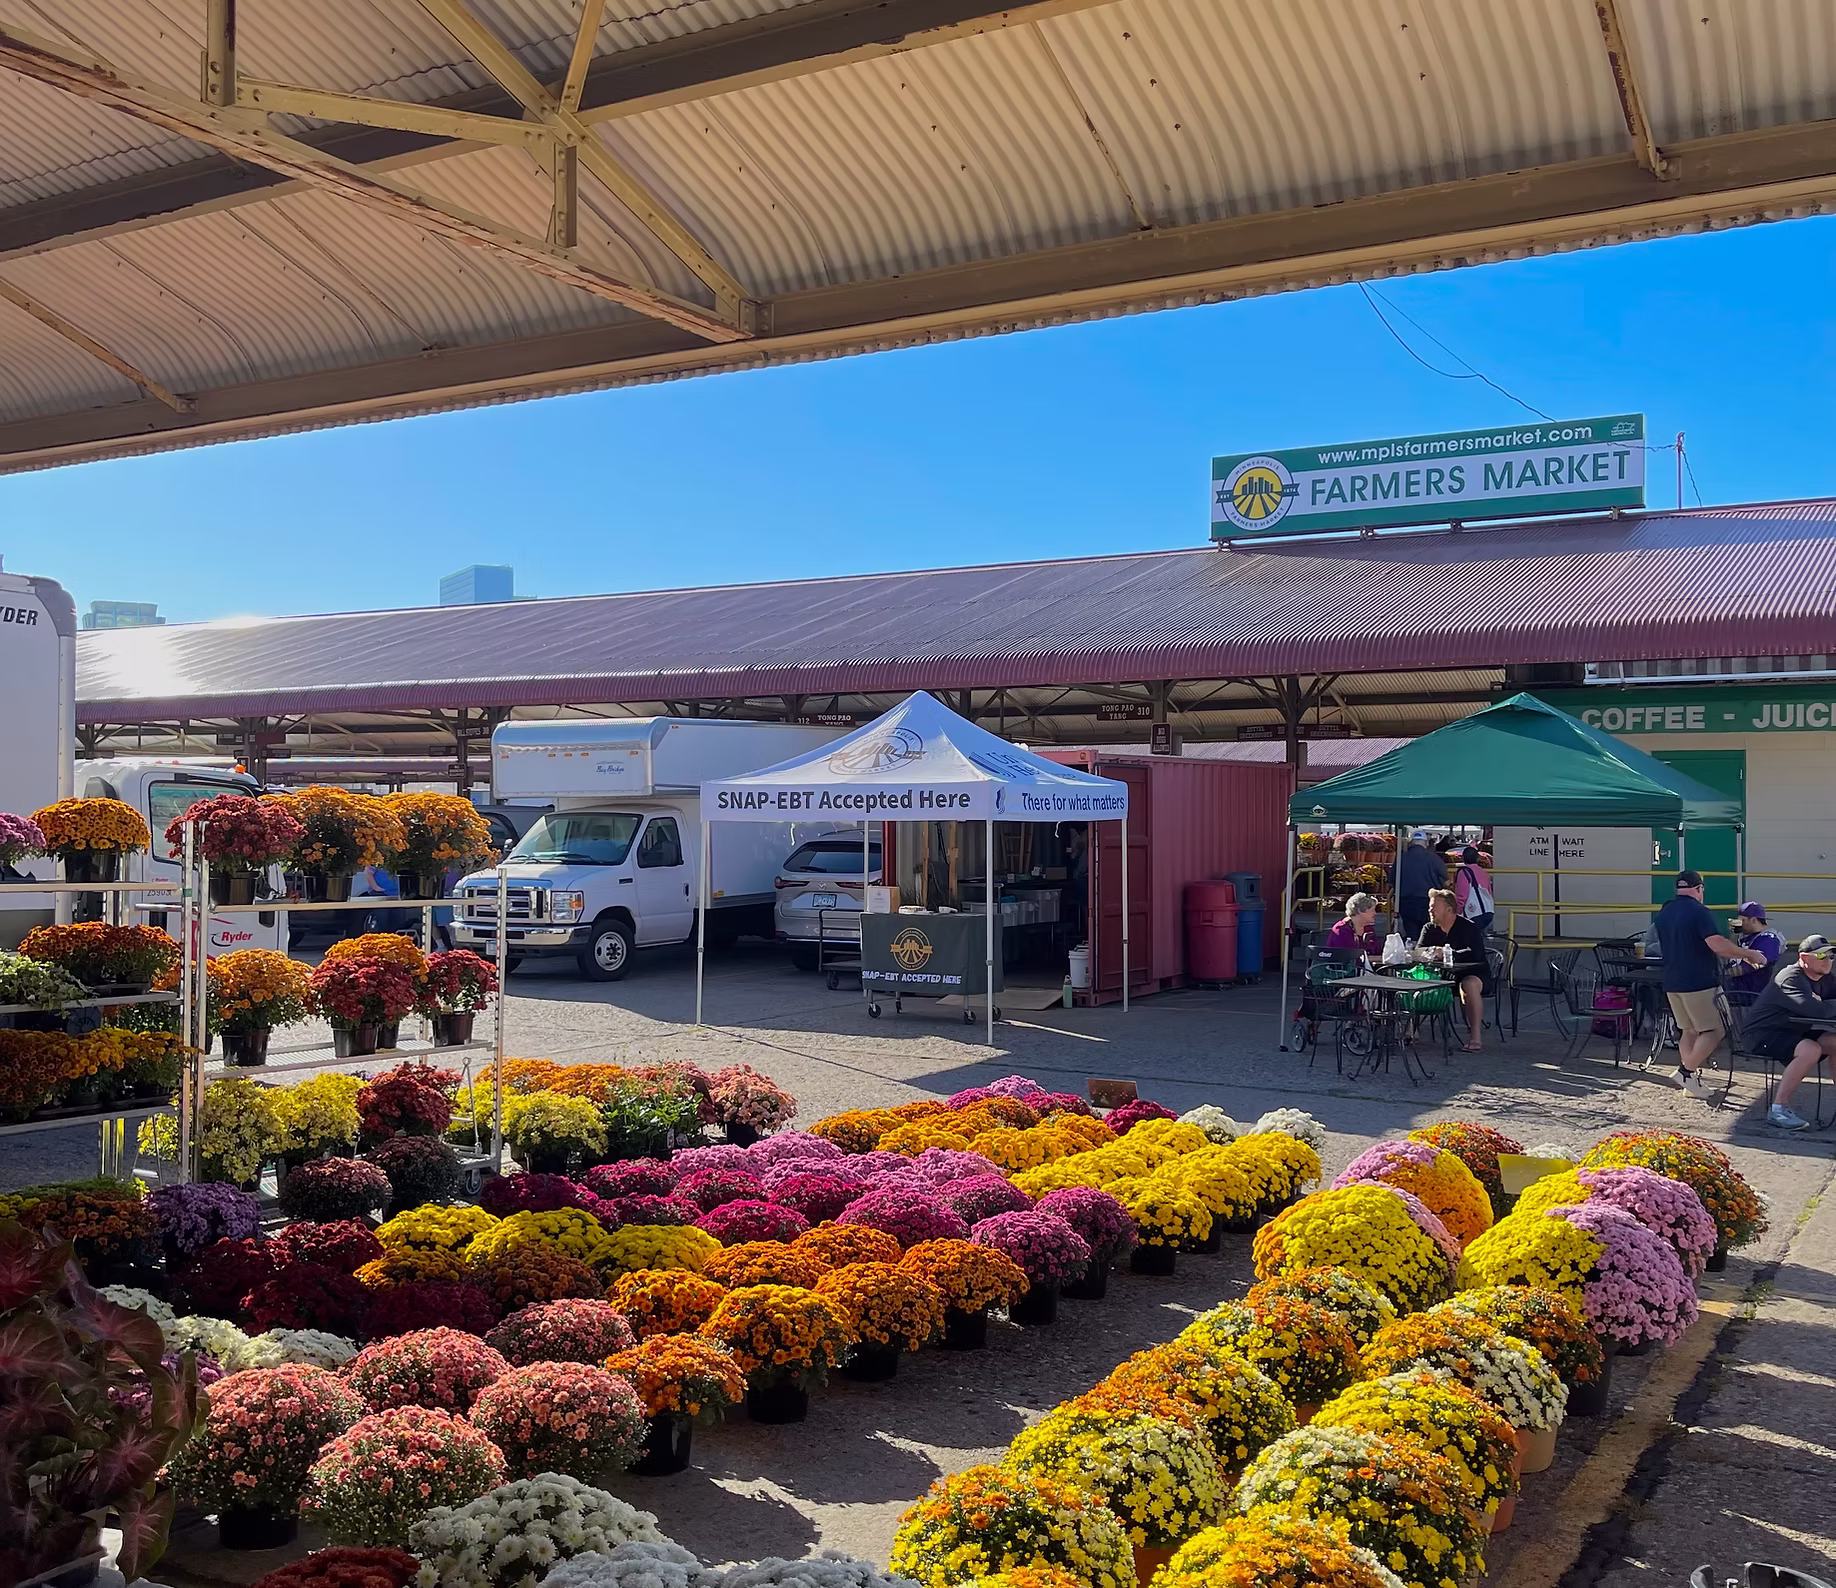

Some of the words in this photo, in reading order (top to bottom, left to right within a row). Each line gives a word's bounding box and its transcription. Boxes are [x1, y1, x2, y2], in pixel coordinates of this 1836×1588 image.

[1317, 424, 1592, 464] www.mplsfarmersmarket.com
[1235, 460, 1280, 475] MINNEAPOLIS
[1310, 465, 1466, 506] FARMERS
[1483, 450, 1630, 491] MARKET
[1230, 511, 1258, 528] FARMERS
[1260, 507, 1284, 527] MARKET
[1102, 704, 1119, 712] TONG
[1137, 706, 1150, 715] 310
[1581, 705, 1705, 731] COFFEE
[1752, 702, 1836, 729] JUIC
[717, 791, 814, 810] SNAP-EBT
[819, 789, 913, 813] Accepted
[919, 790, 971, 809] Here
[1022, 792, 1051, 811] There
[1052, 793, 1067, 810] for
[1068, 794, 1091, 811] what
[1092, 795, 1125, 810] matters
[1529, 837, 1549, 845] ATM
[1561, 838, 1585, 846] WAIT
[1529, 848, 1549, 856] LINE
[1559, 850, 1585, 858] HERE
[220, 931, 254, 944] Ryder
[861, 970, 899, 981] SNAP-EBT
[901, 973, 941, 983] ACCEPTED
[942, 974, 962, 984] HERE
